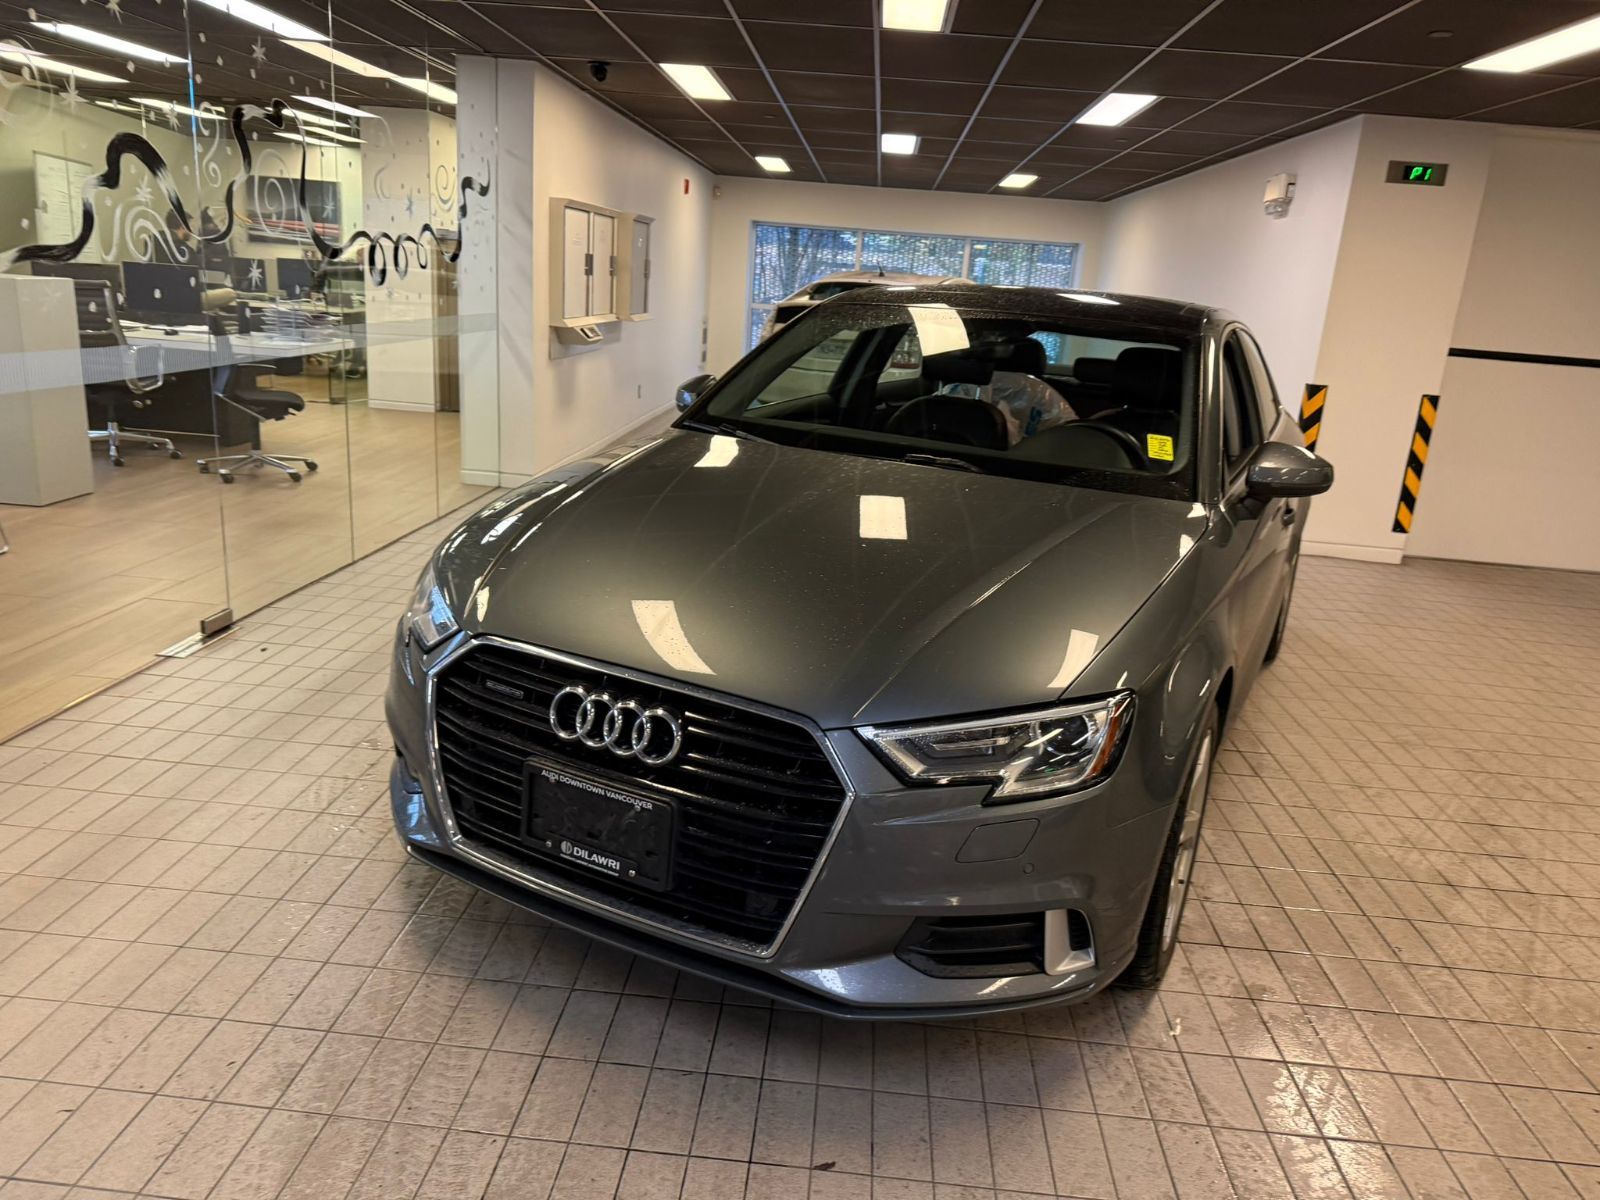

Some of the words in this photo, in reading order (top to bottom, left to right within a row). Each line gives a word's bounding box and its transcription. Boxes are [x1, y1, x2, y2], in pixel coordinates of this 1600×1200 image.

[1409, 166, 1433, 181] P1
[541, 769, 559, 780] AUDI
[559, 775, 605, 796] DOWNTOWN
[605, 791, 653, 810] VANCOUVER
[573, 846, 621, 871] DILAWRI
